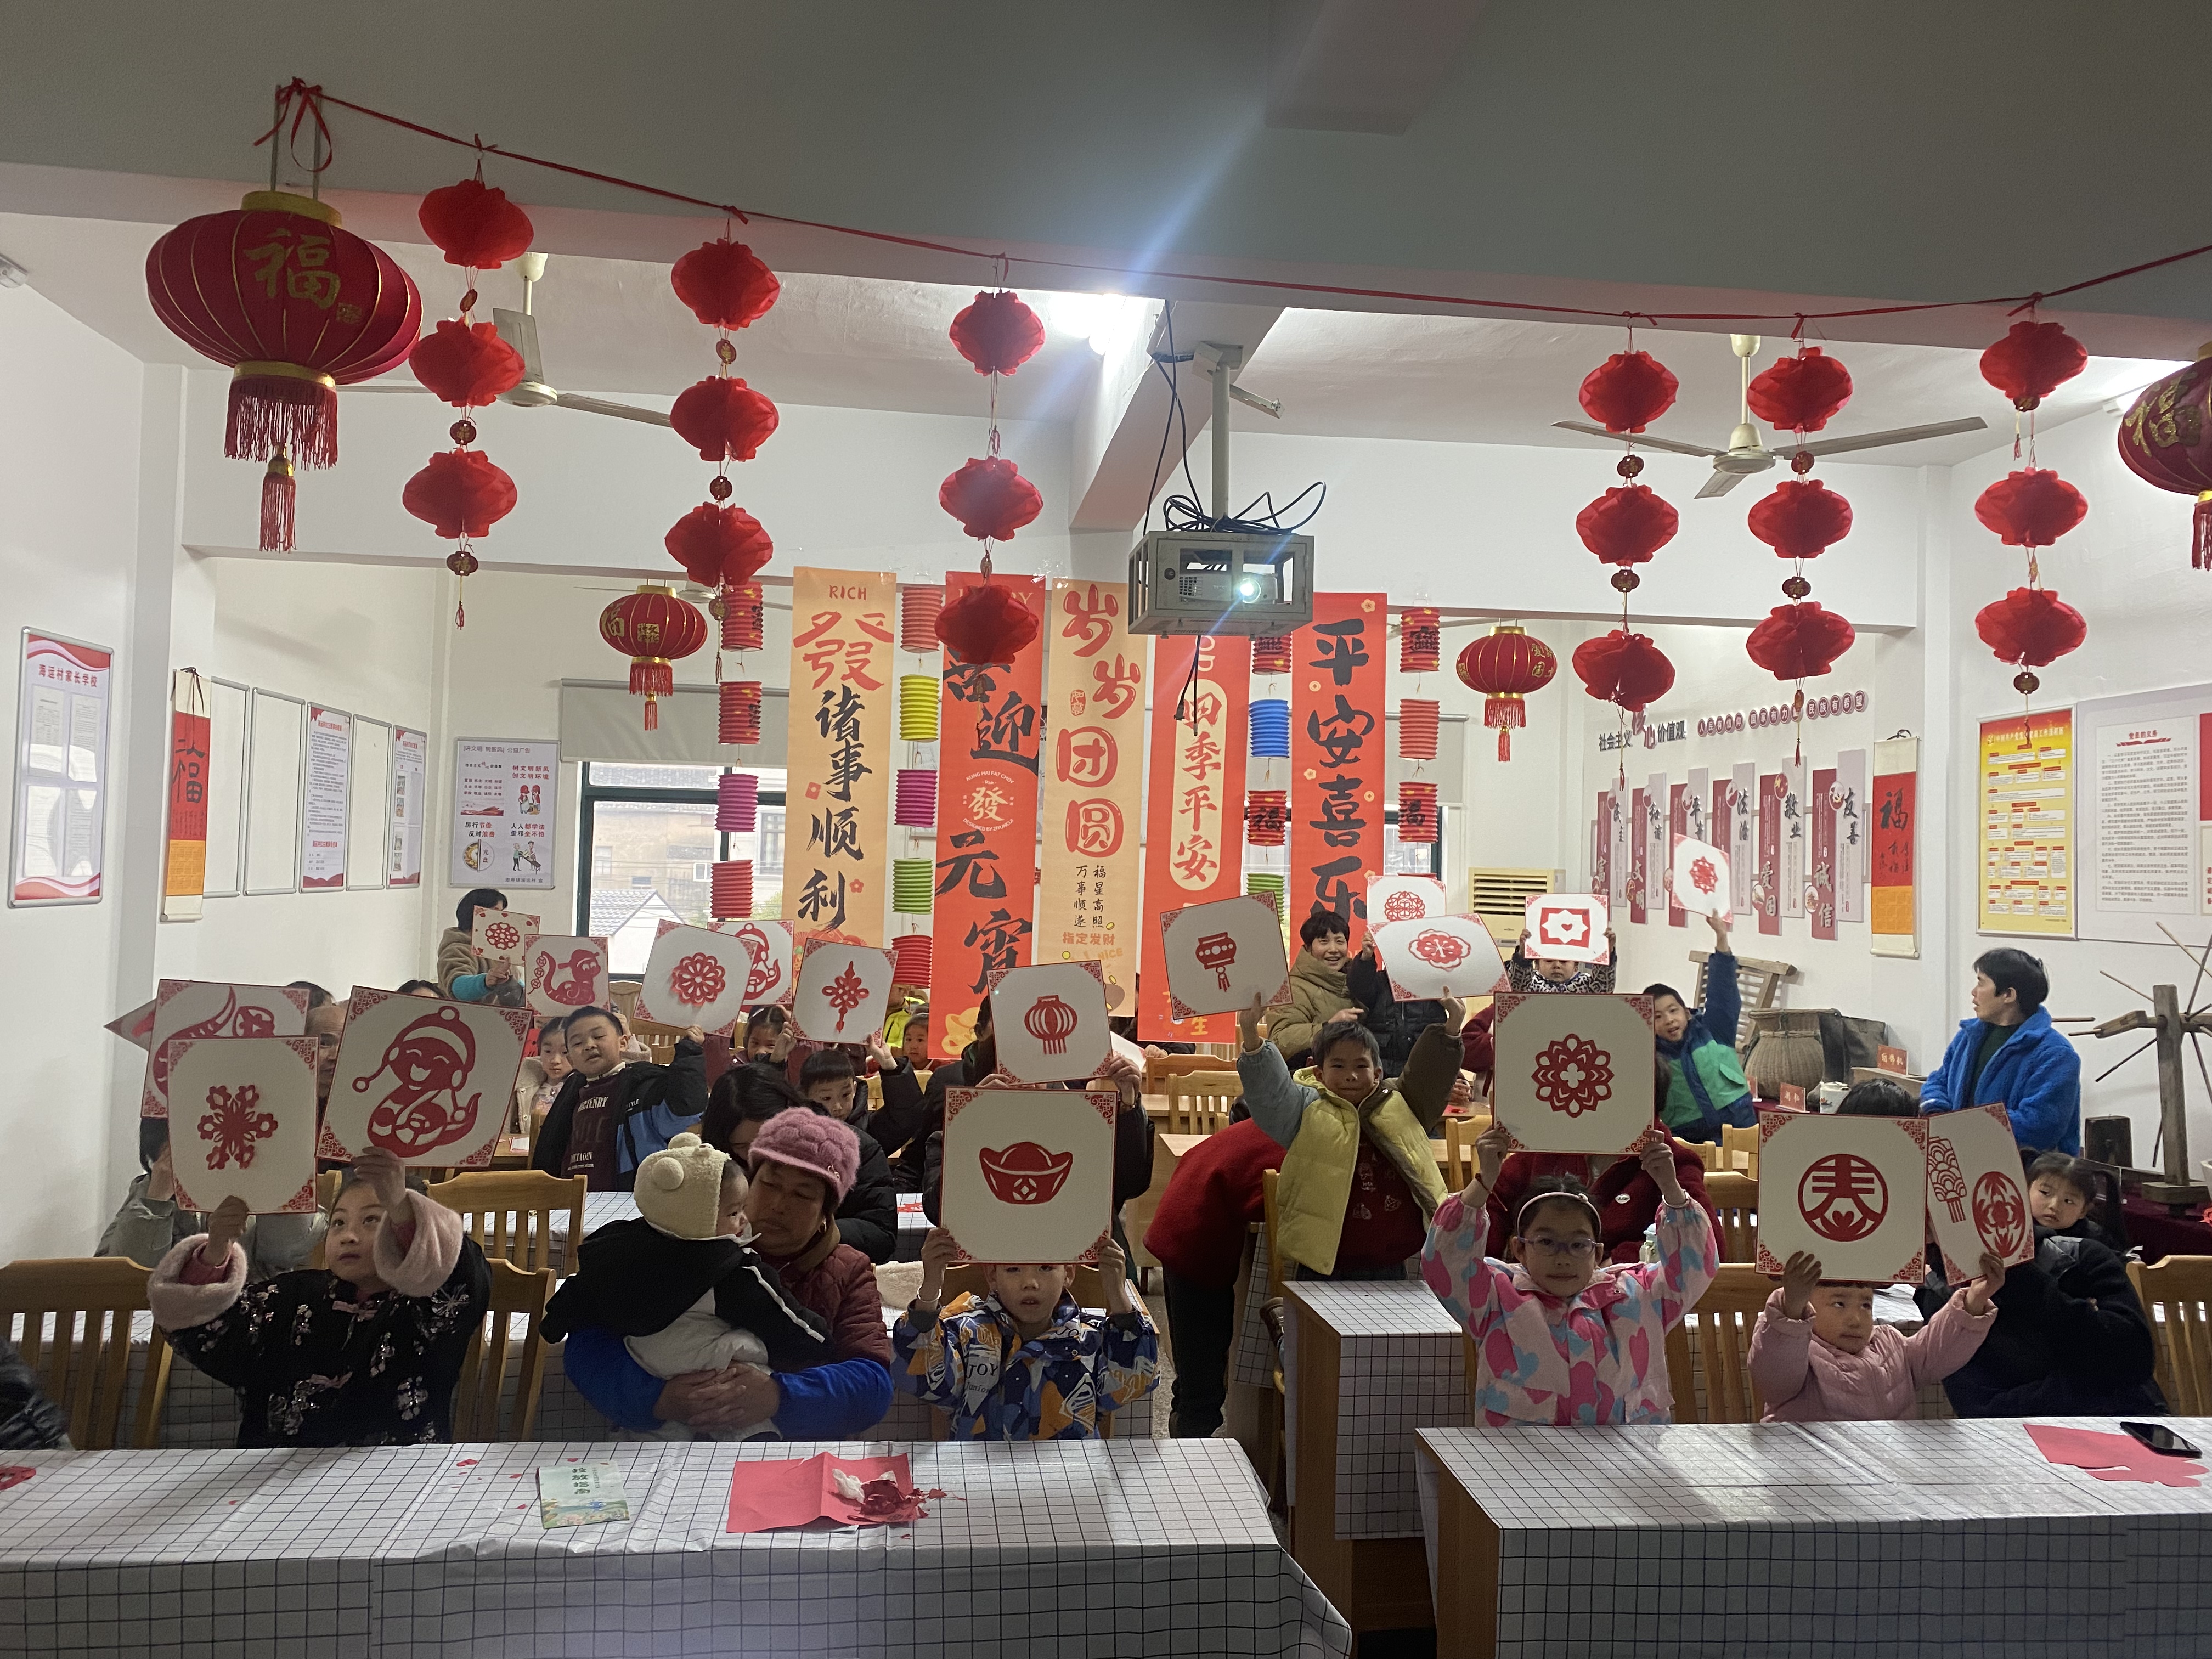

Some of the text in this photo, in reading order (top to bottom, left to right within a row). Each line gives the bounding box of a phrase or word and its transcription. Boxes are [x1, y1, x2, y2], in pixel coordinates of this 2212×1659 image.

[243, 228, 341, 309] 福
[2125, 371, 2201, 458] 福
[830, 585, 867, 600] RICH
[793, 611, 894, 691] 發
[1056, 584, 1141, 857] 岁岁团圆
[1699, 716, 1742, 732] 人民有信仰
[1808, 695, 1863, 714] 民族有希望
[797, 684, 873, 932] 诸事顺利
[966, 772, 981, 781] KUNG
[968, 787, 1008, 821] 發
[1173, 690, 1222, 882] 四季平安
[1253, 806, 1283, 831] 福
[1074, 865, 1088, 928] 万事顺遂
[1092, 865, 1107, 928] 福星高照
[1062, 932, 1115, 945] 指定发财
[1802, 1154, 1886, 1242] 春
